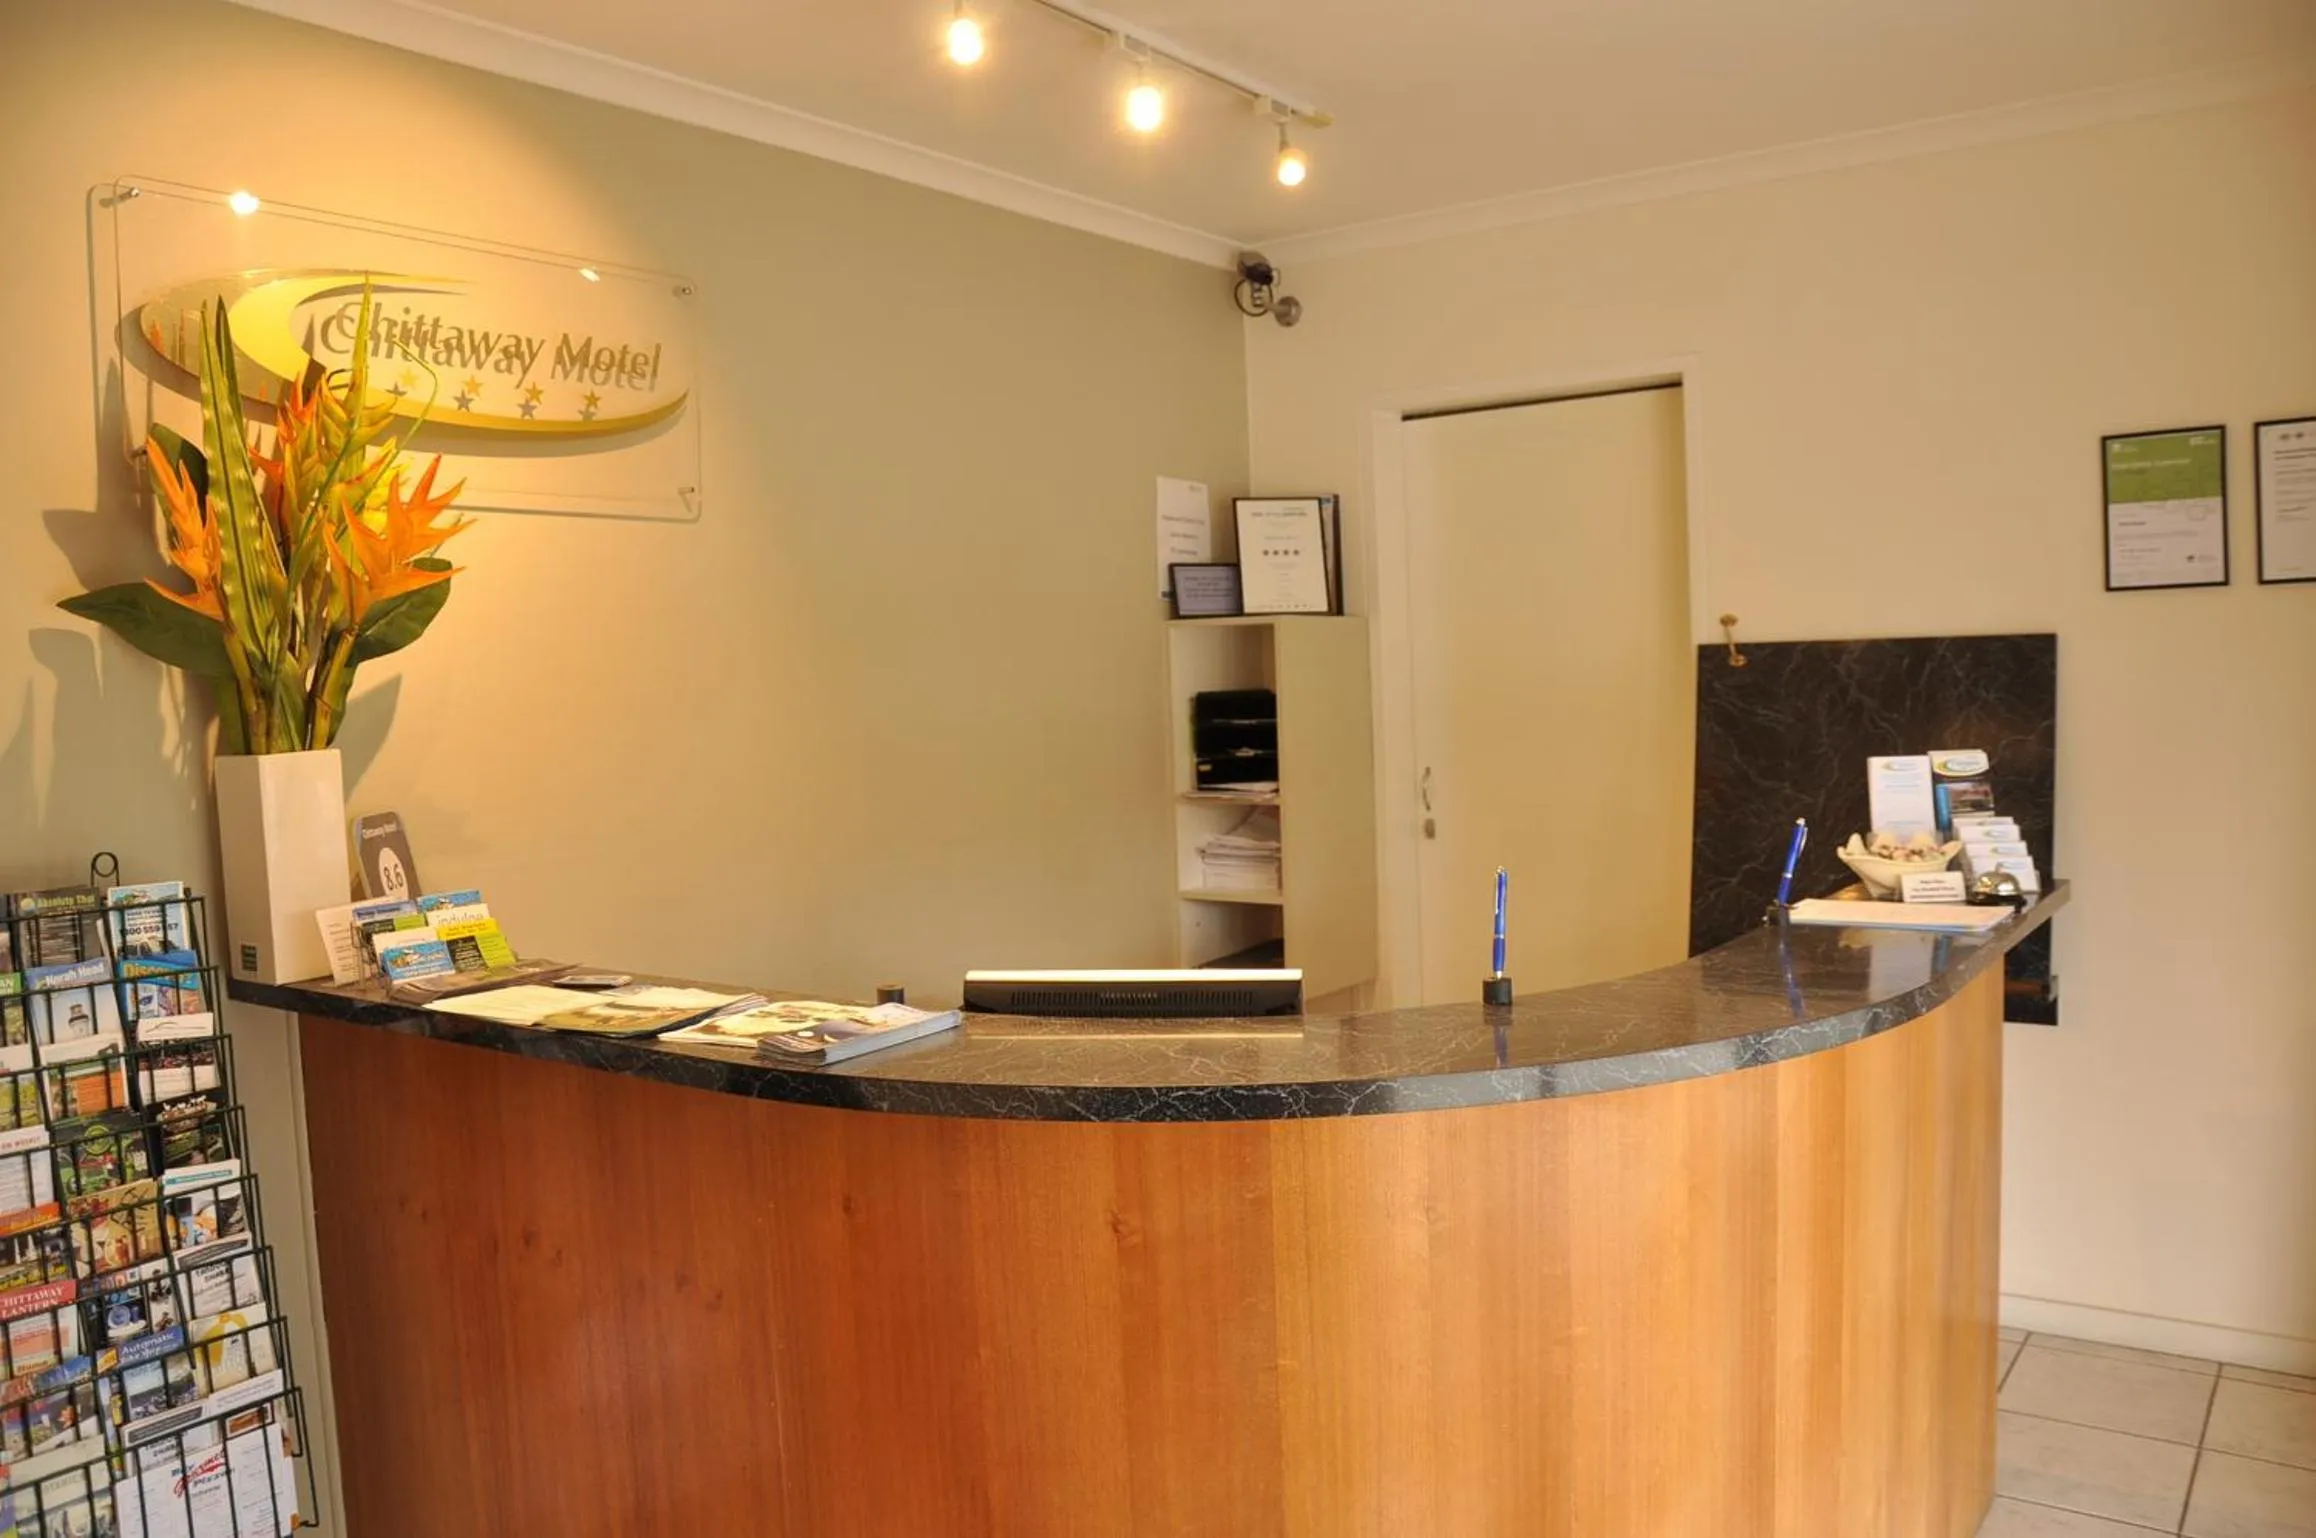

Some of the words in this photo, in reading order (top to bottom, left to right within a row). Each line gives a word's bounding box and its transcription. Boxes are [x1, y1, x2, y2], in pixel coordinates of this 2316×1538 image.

[336, 301, 546, 389] Chittaway
[556, 331, 663, 382] Motel
[0, 1286, 65, 1308] HITTAWAY
